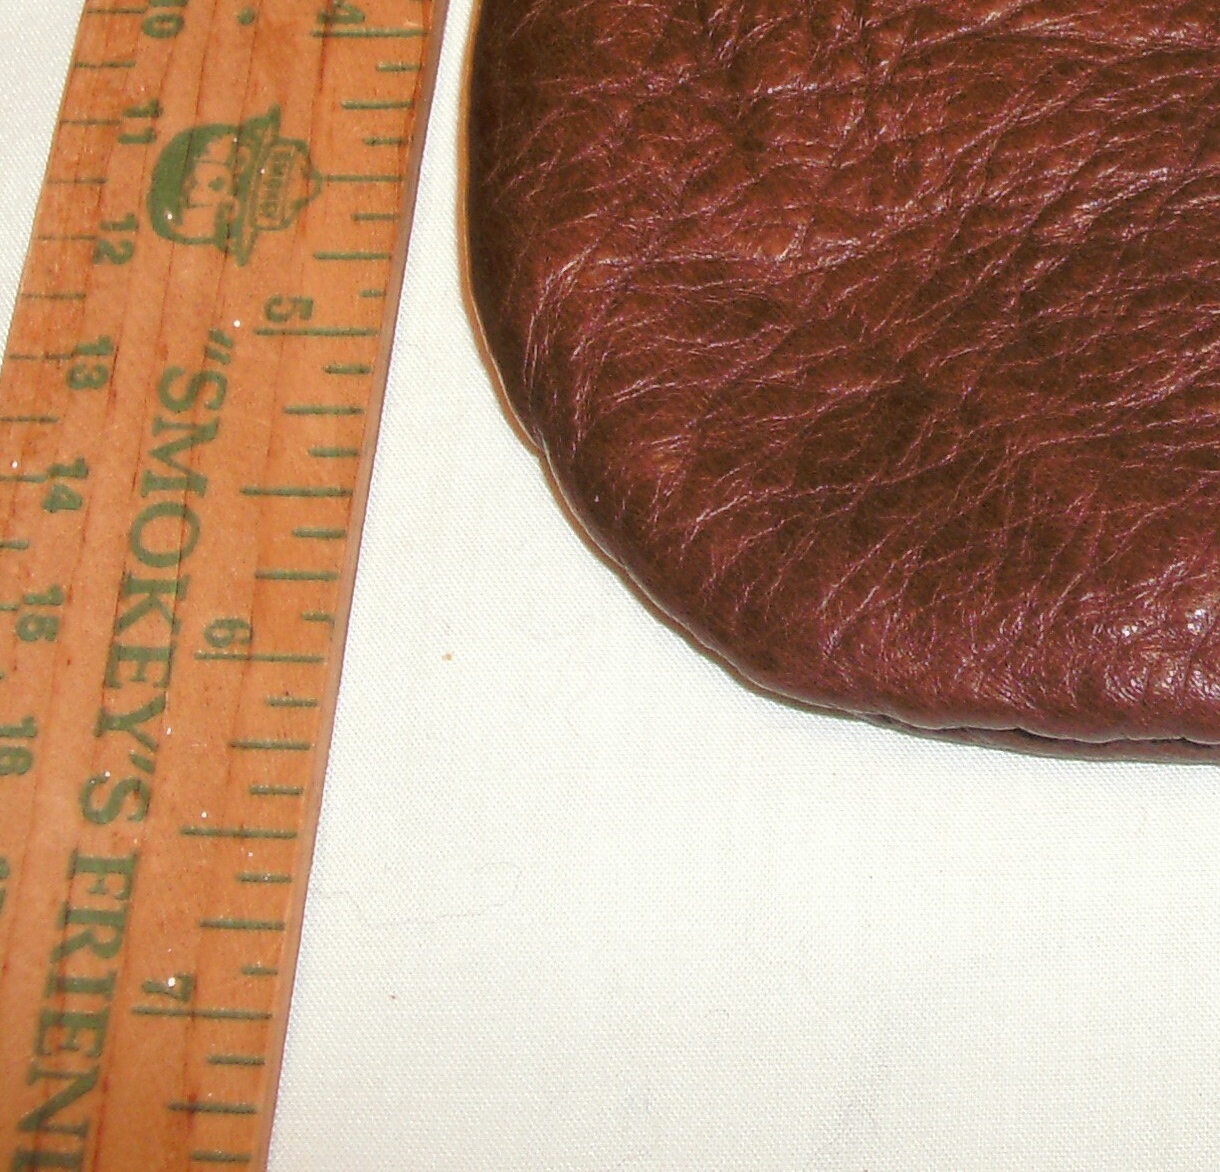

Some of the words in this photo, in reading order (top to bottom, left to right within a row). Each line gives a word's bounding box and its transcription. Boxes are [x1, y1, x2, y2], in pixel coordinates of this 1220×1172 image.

[117, 98, 163, 145] 11
[93, 212, 140, 266] 12
[263, 294, 314, 324] 5
[66, 334, 115, 391] 13
[41, 457, 90, 515] 14
[16, 584, 65, 643] 15
[204, 616, 254, 649] 6
[141, 972, 195, 1002] 7
